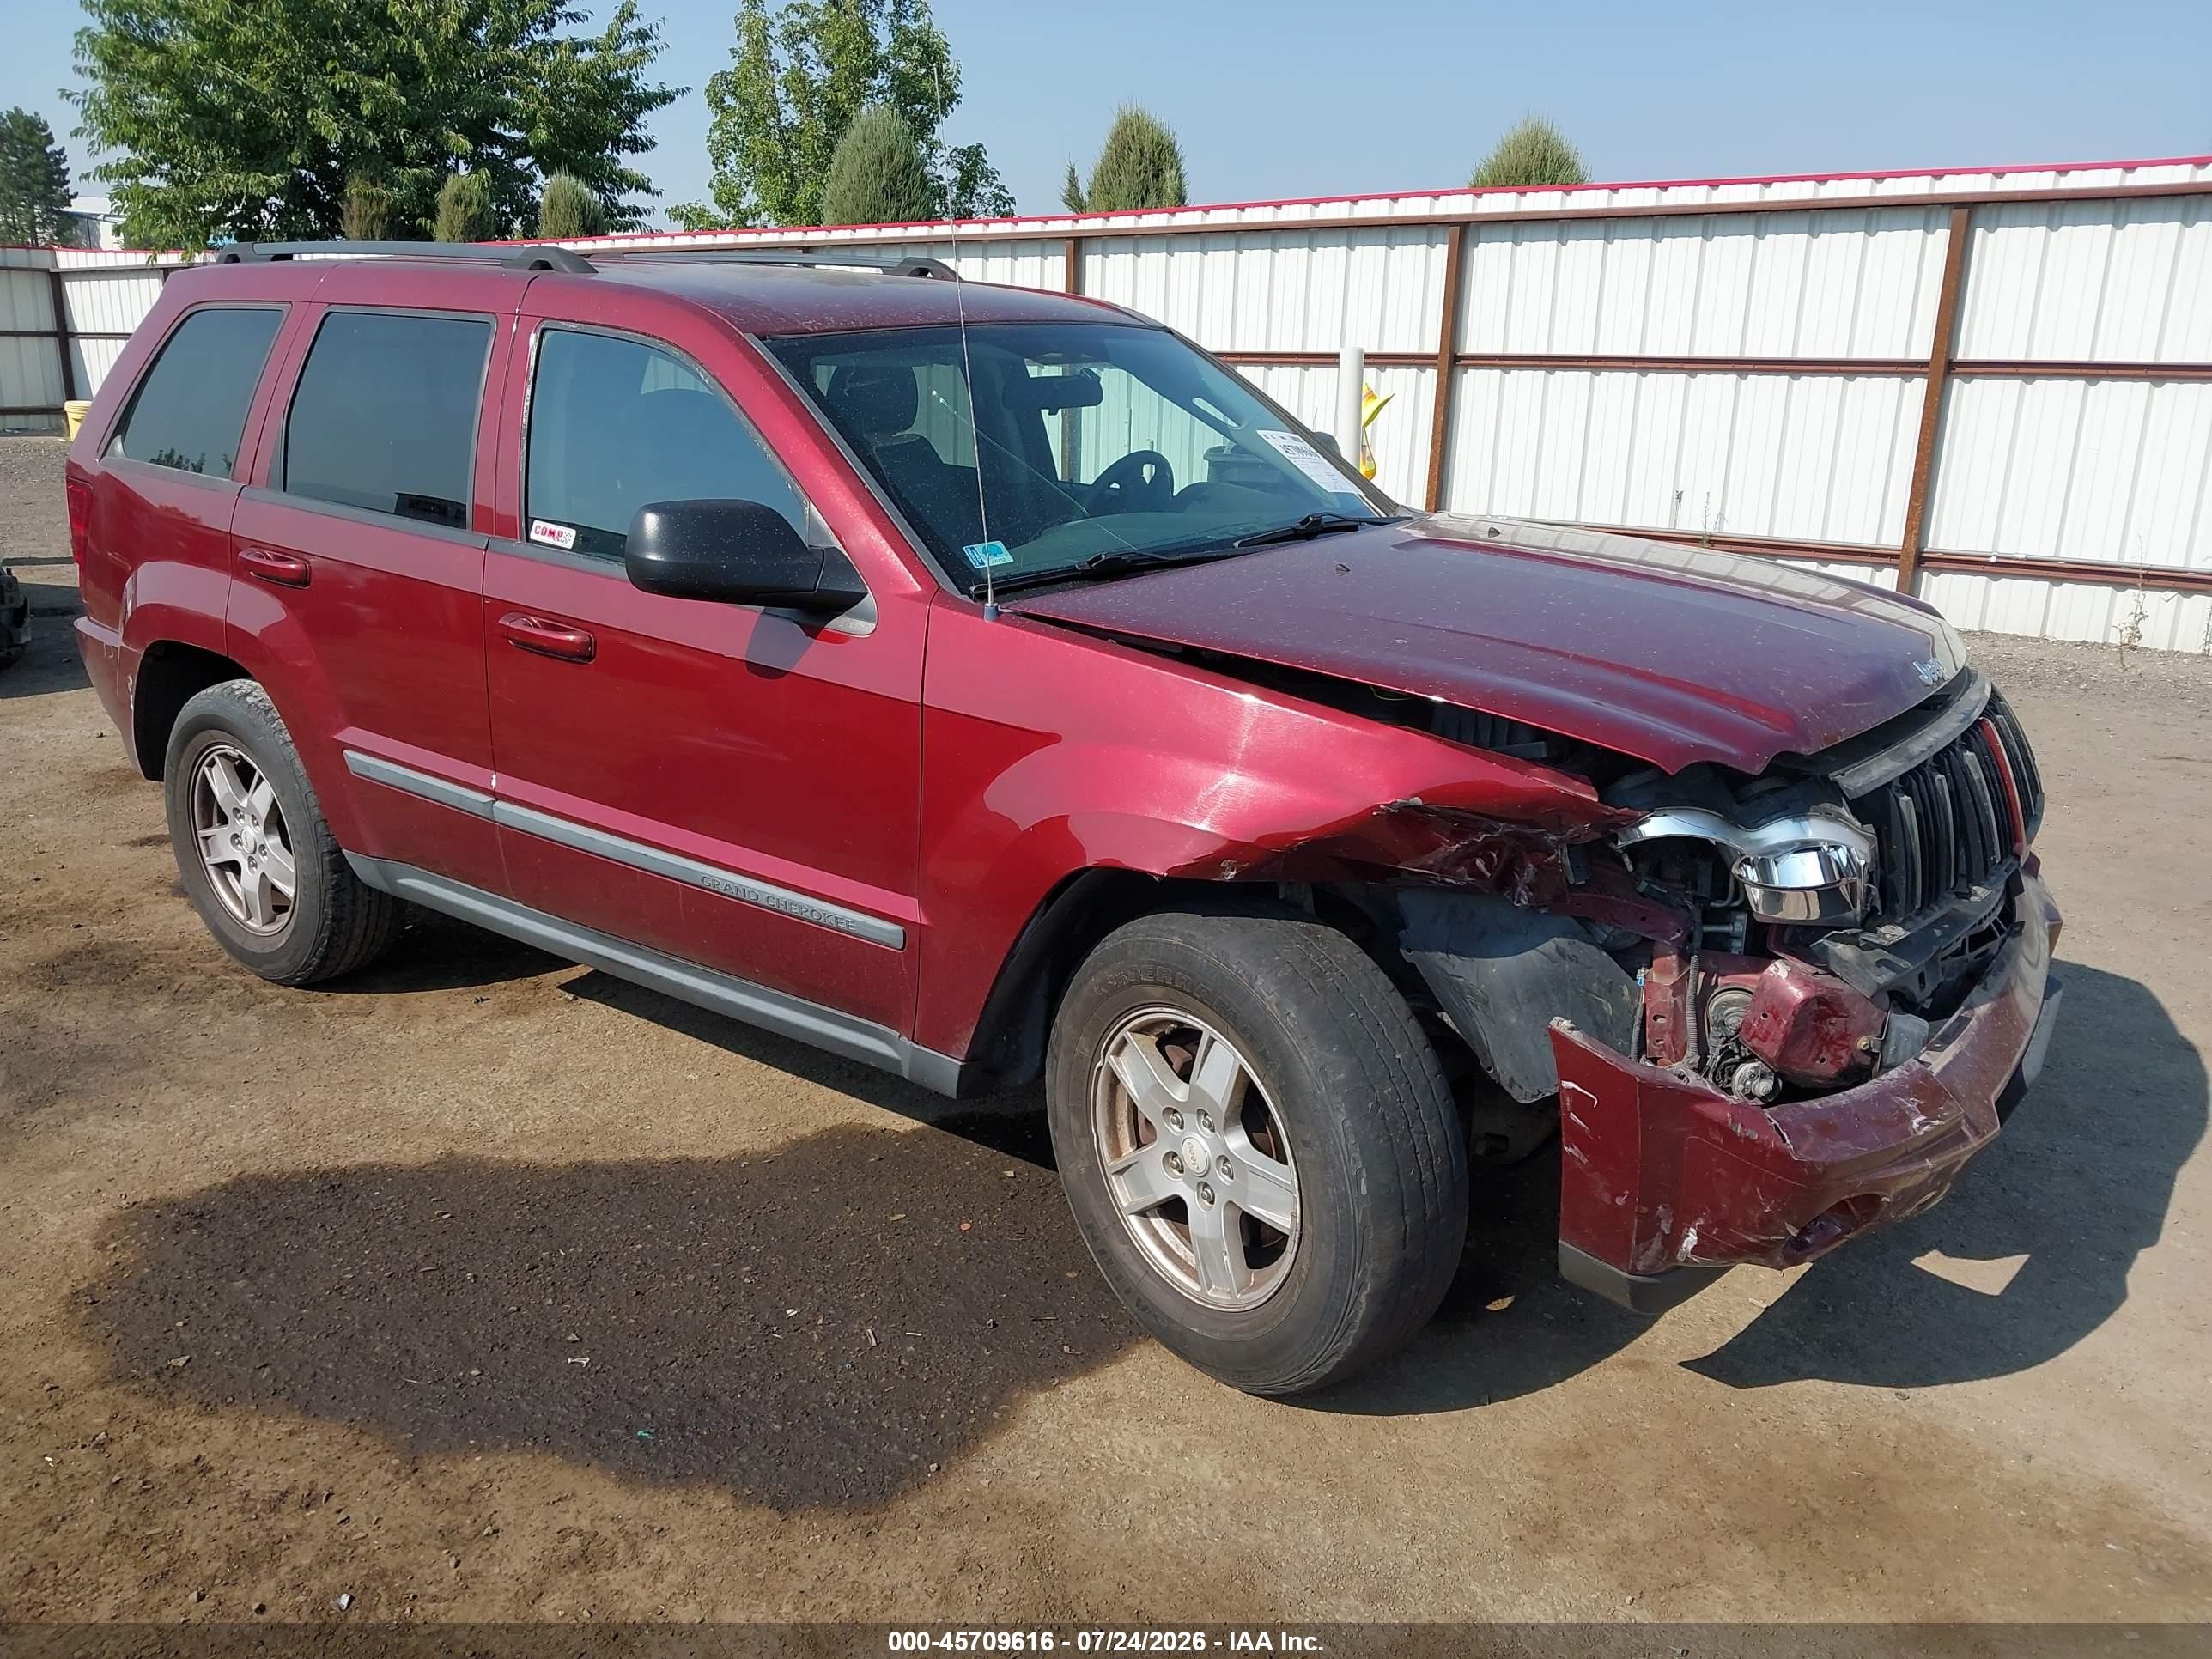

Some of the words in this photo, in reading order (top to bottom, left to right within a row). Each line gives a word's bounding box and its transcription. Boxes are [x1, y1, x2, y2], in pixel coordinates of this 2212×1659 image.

[534, 525, 563, 538] COMP
[701, 875, 759, 902] GRAND
[766, 895, 859, 932] CHEROKEE
